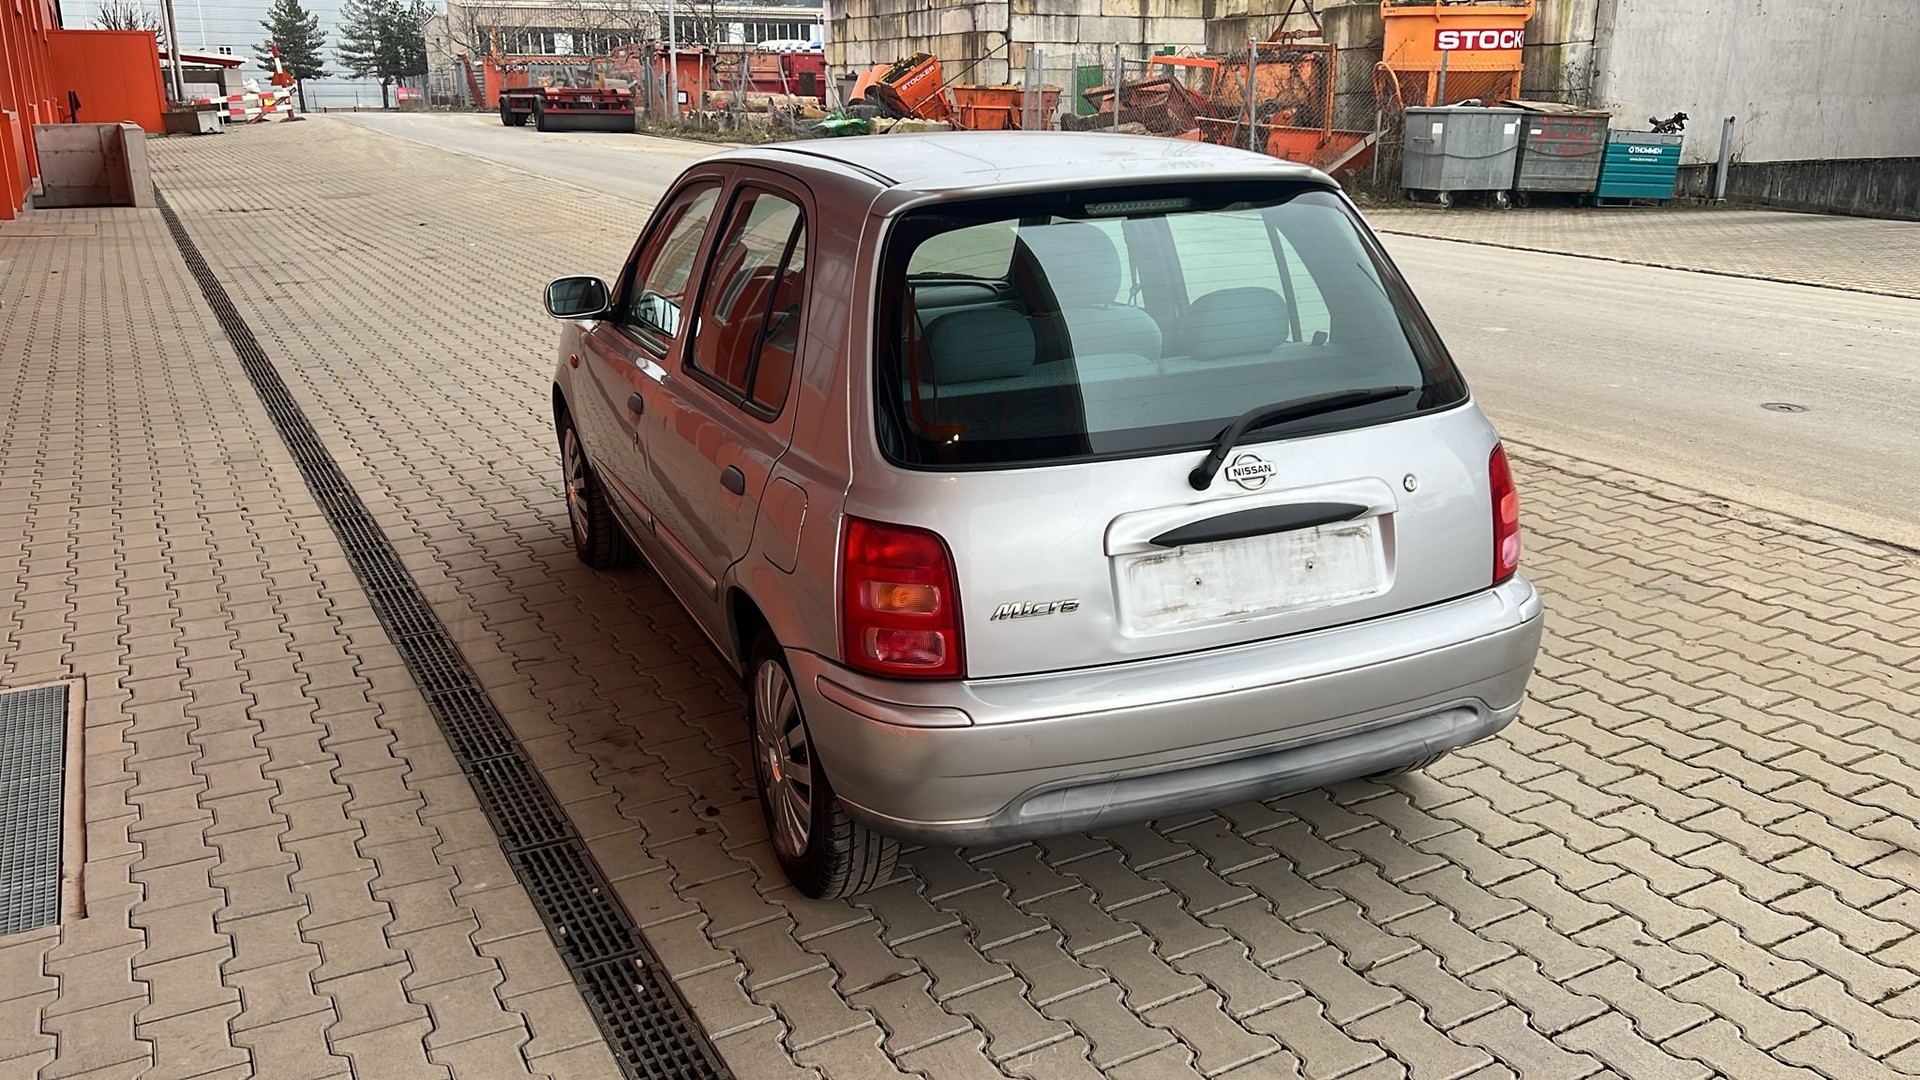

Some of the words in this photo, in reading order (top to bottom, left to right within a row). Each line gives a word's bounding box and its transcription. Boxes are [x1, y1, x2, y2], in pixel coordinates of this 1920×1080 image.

[1438, 30, 1525, 49] STOCK
[901, 65, 935, 91] STOCKER
[1233, 464, 1272, 477] NISSAN
[990, 599, 1080, 621] Micra
